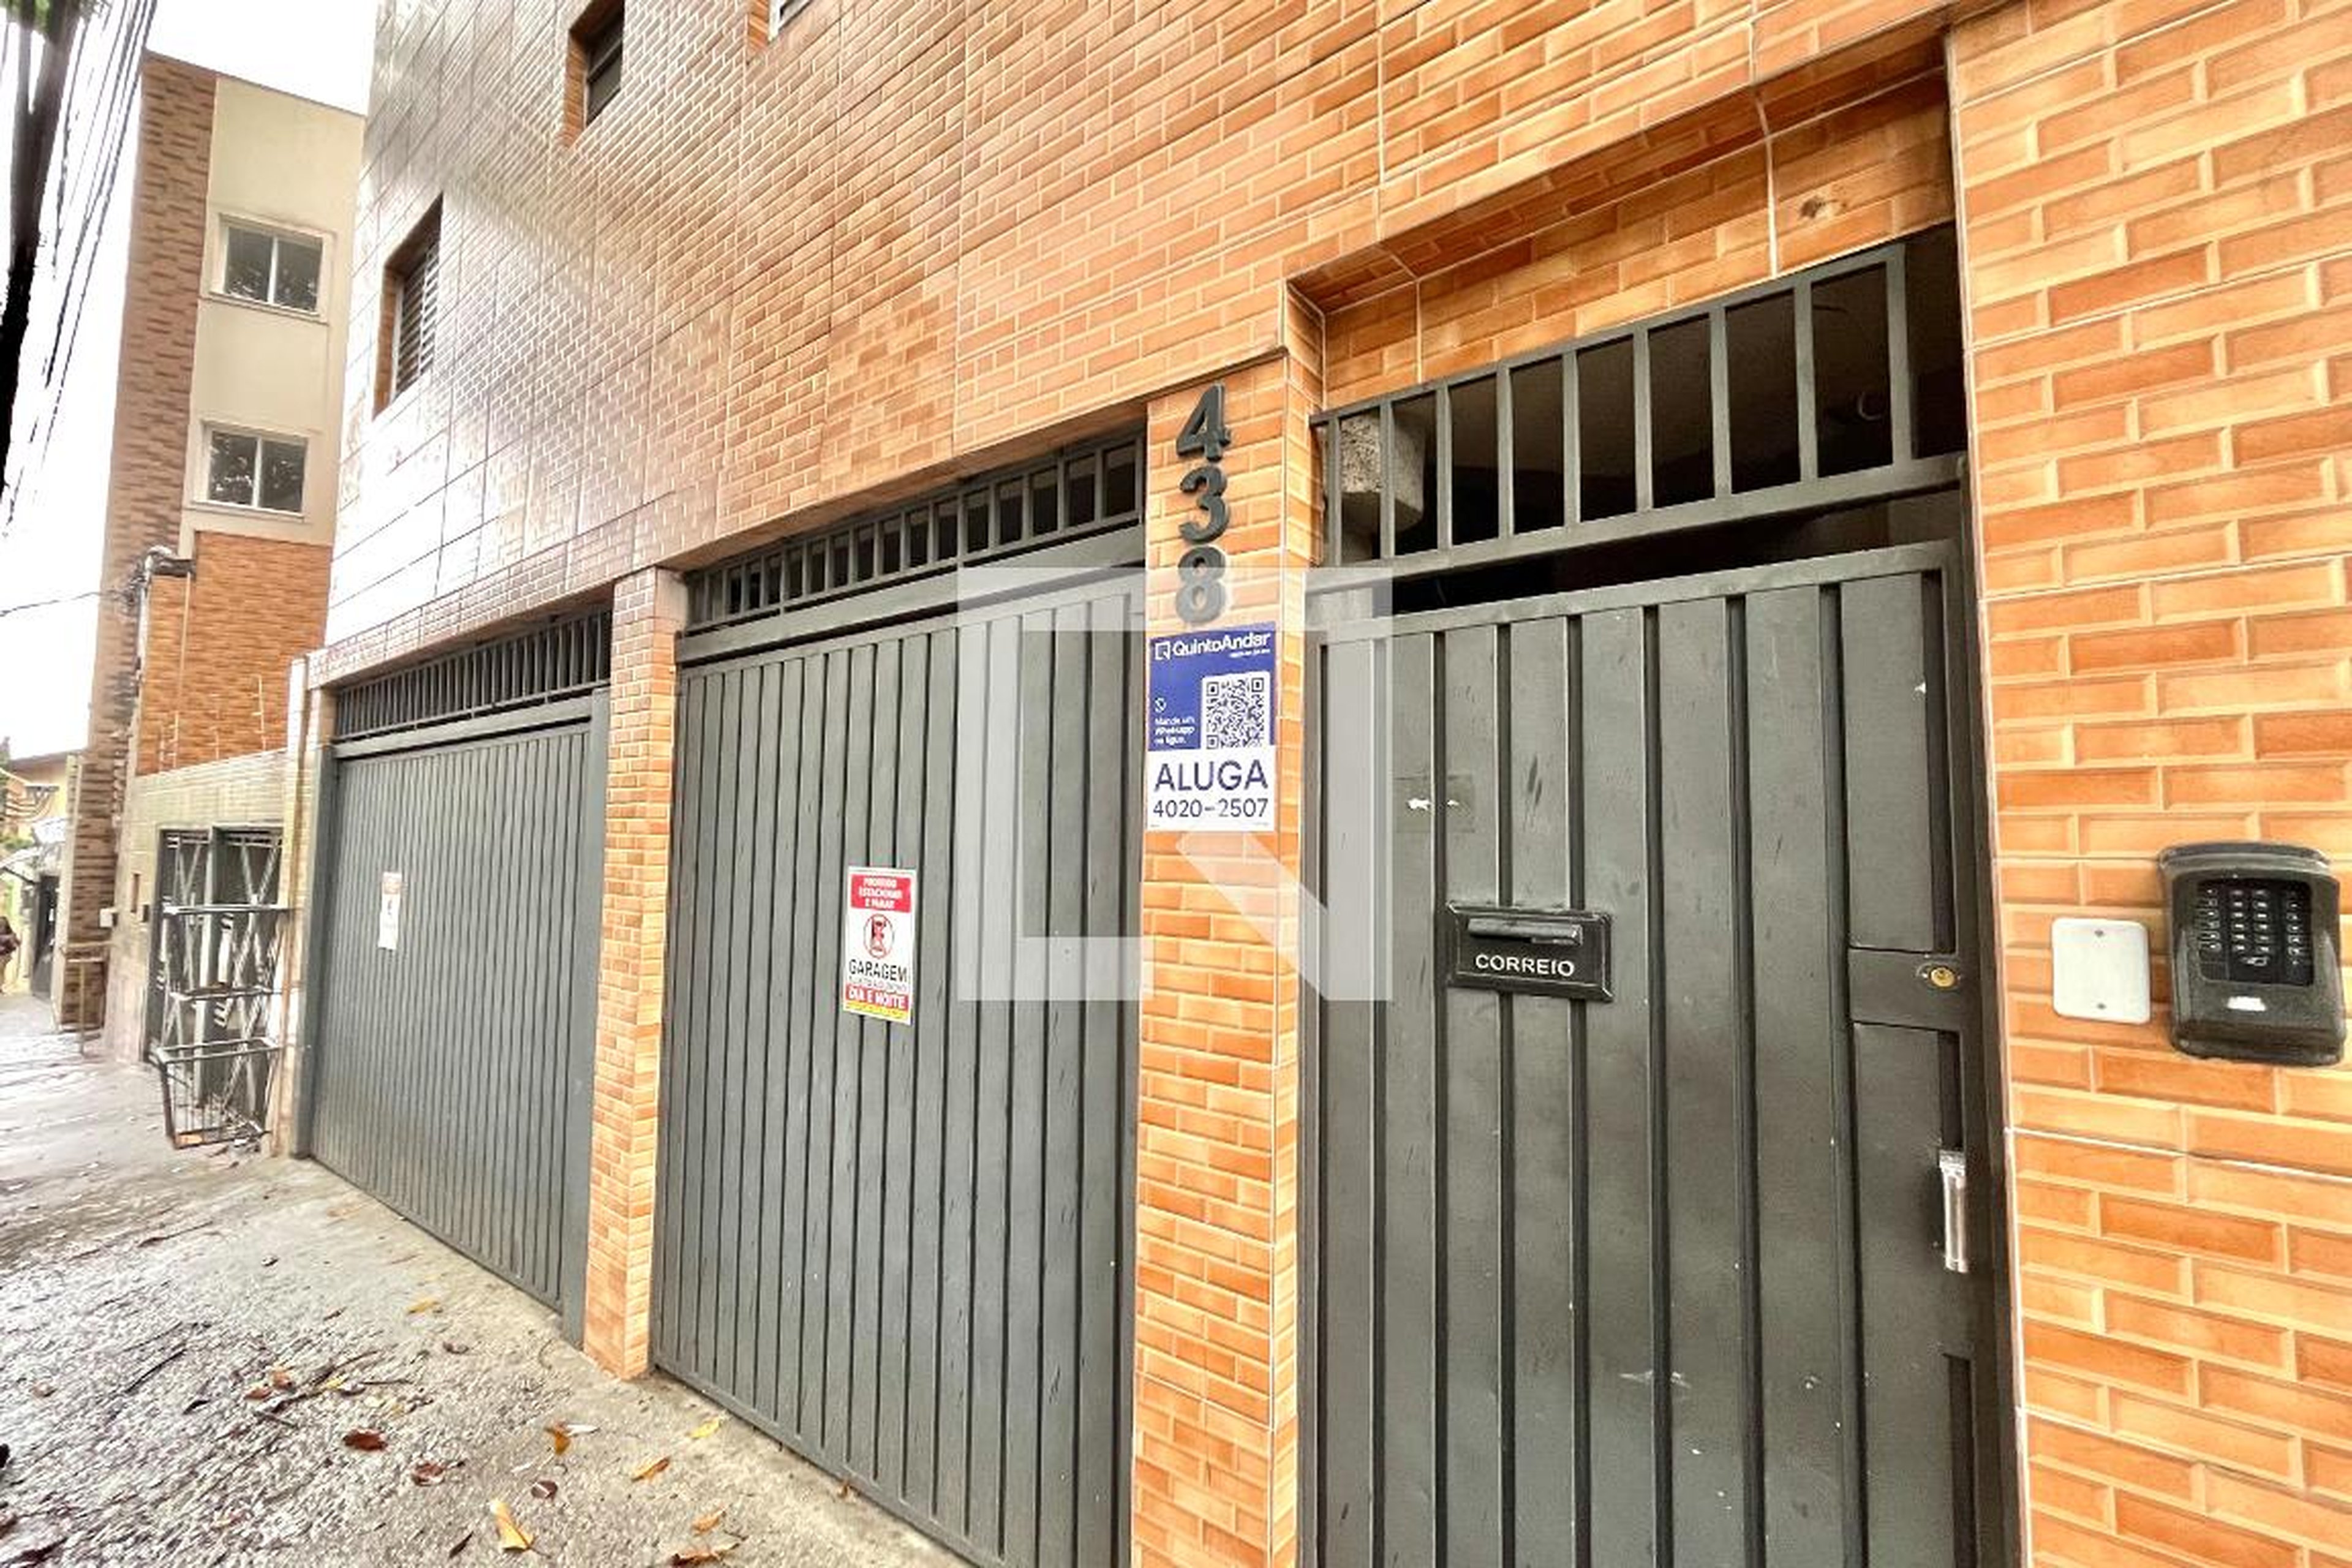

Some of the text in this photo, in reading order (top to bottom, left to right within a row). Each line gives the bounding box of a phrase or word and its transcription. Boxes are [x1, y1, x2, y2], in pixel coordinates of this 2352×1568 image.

[1176, 383, 1231, 624] 438
[1172, 633, 1271, 656] QuintoAndar
[1154, 759, 1268, 791] ALUGA
[1153, 798, 1268, 818] 4020-2507
[849, 959, 907, 982] GARAGEM
[1476, 954, 1575, 977] CORREIO
